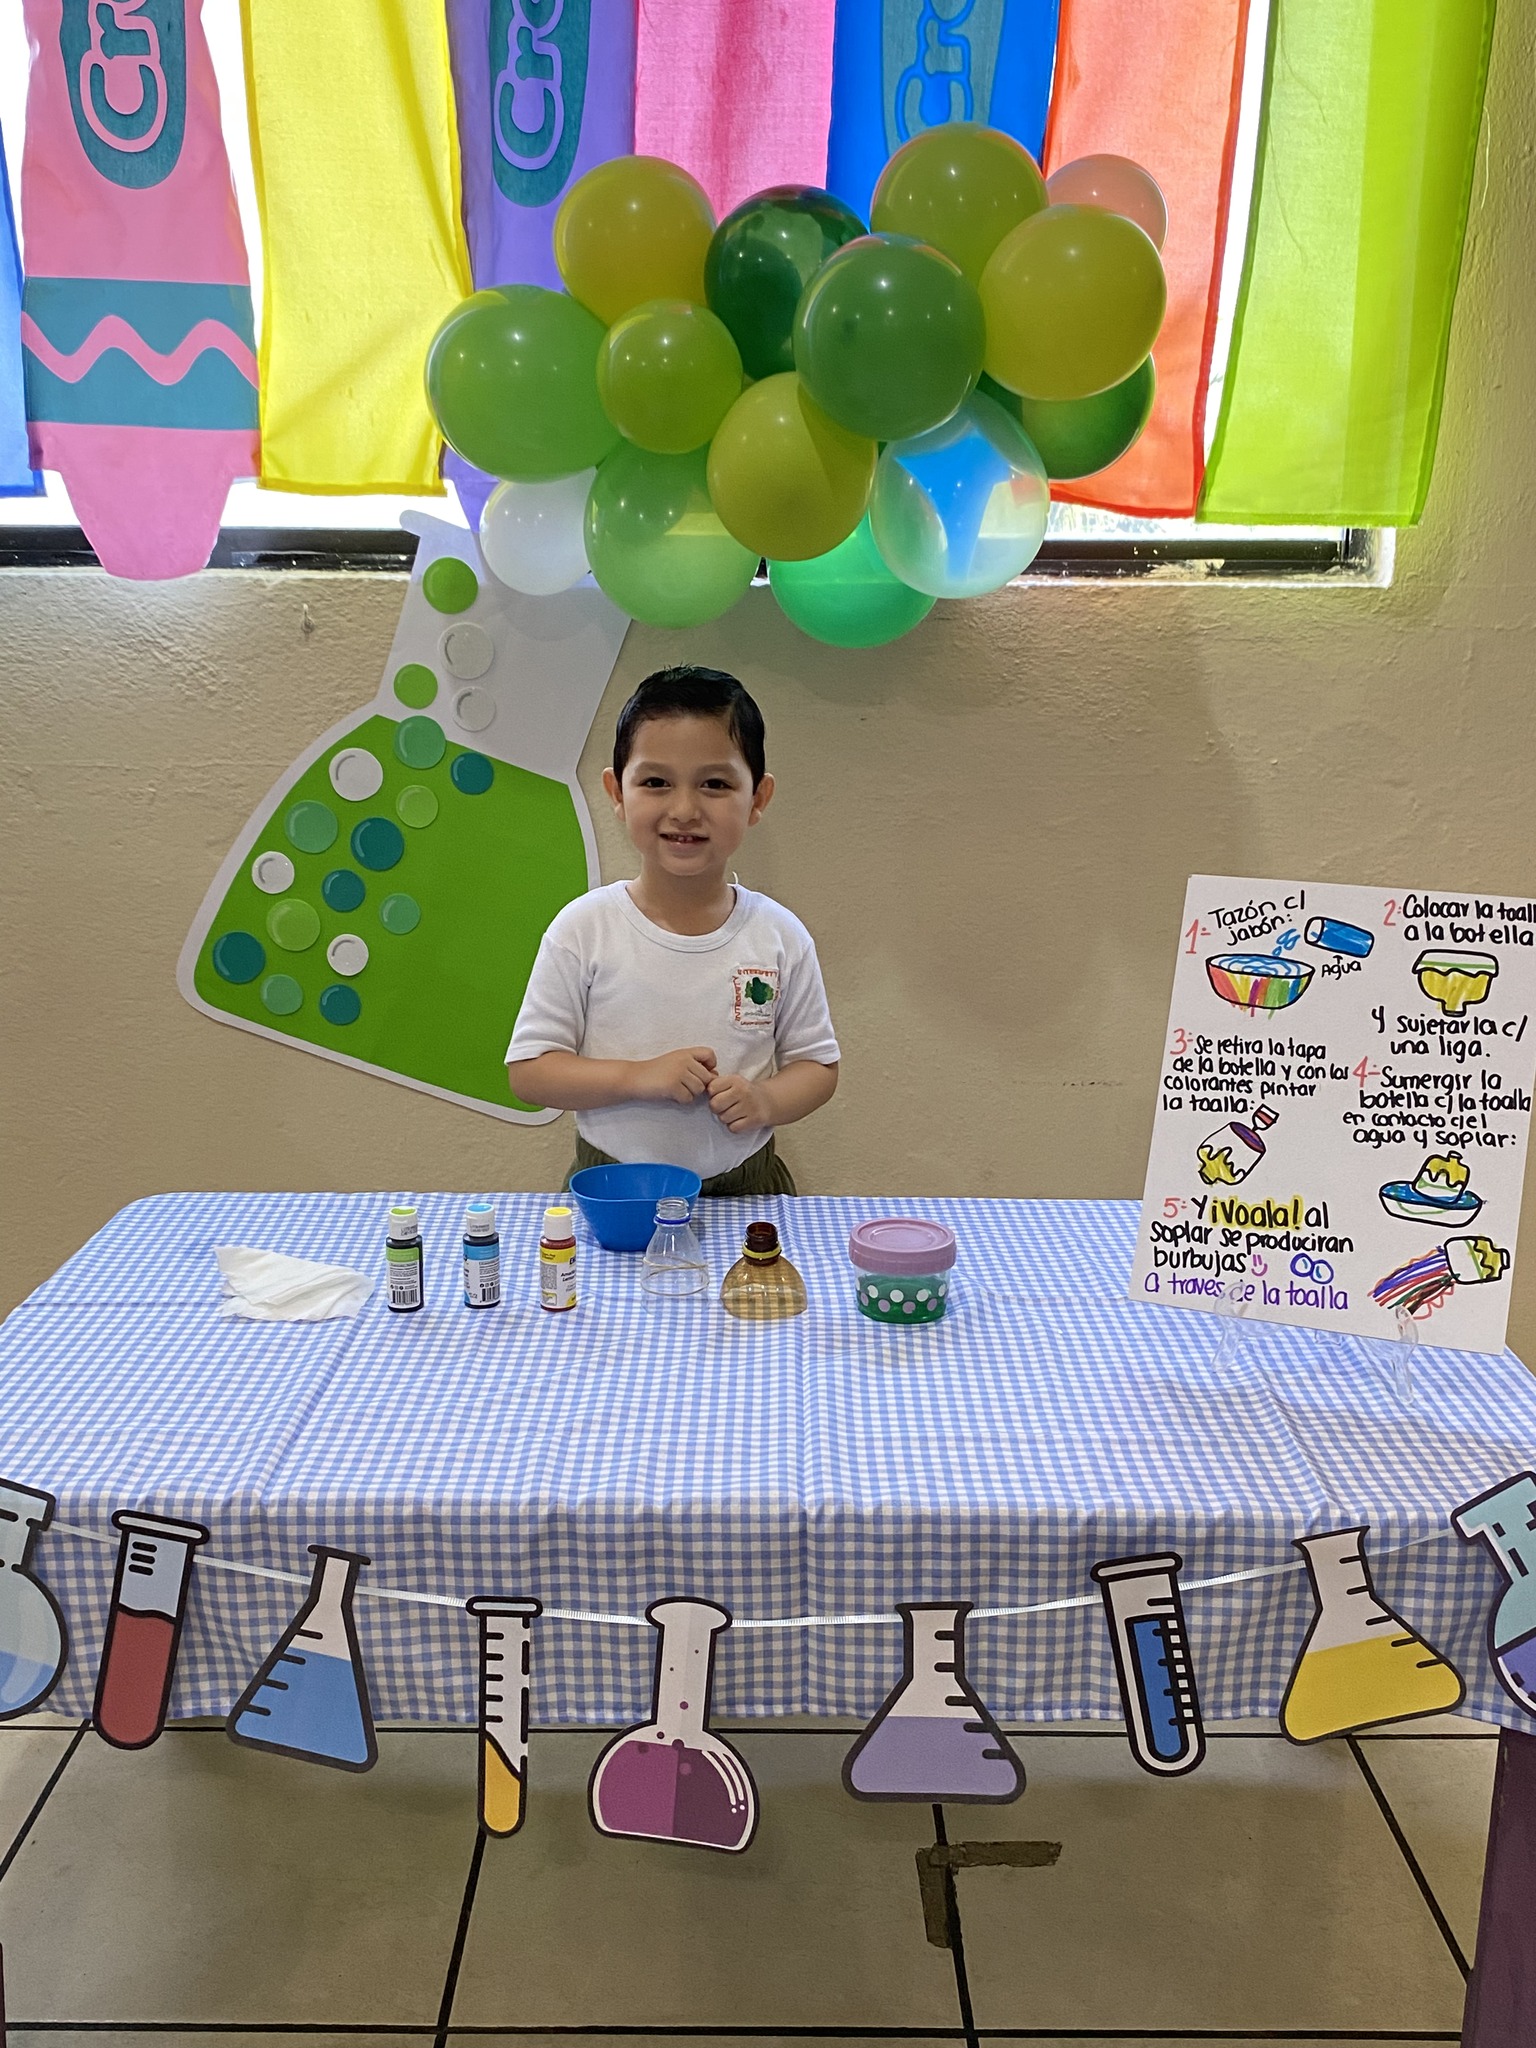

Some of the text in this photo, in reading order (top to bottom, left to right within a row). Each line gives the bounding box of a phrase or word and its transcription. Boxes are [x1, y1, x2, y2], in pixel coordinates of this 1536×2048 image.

[1208, 900, 1277, 929] Tazón
[1403, 894, 1469, 918] Colocar
[1475, 900, 1493, 919] la
[1227, 914, 1292, 946] jabón:
[1404, 921, 1534, 946] a la botella
[1502, 1015, 1528, 1042] c/
[1194, 1035, 1213, 1055] Se
[1217, 1035, 1263, 1056] retira
[1268, 1038, 1285, 1056] la
[1287, 1037, 1326, 1062] tapa
[1390, 1035, 1491, 1064] una liga.
[1172, 1056, 1350, 1081] de la botella y con los
[1380, 1066, 1473, 1095] Sumergir
[1481, 1069, 1502, 1090] la
[1163, 1075, 1317, 1099] colorantes pintar
[1359, 1090, 1429, 1109] botella
[1459, 1093, 1477, 1112] la
[1479, 1088, 1532, 1112] toalla
[1163, 1094, 1255, 1113] la toalla:
[1342, 1112, 1365, 1125] en
[1372, 1111, 1446, 1128] contacto
[1353, 1129, 1406, 1149] agua
[1435, 1130, 1516, 1149] soplar:
[1304, 1201, 1329, 1229] al
[1219, 1228, 1242, 1247] se
[1245, 1231, 1354, 1255] produciran
[1154, 1245, 1247, 1277] burbujas
[1167, 1273, 1225, 1299] traves
[1262, 1280, 1280, 1306] la
[1285, 1280, 1348, 1310] toalla
